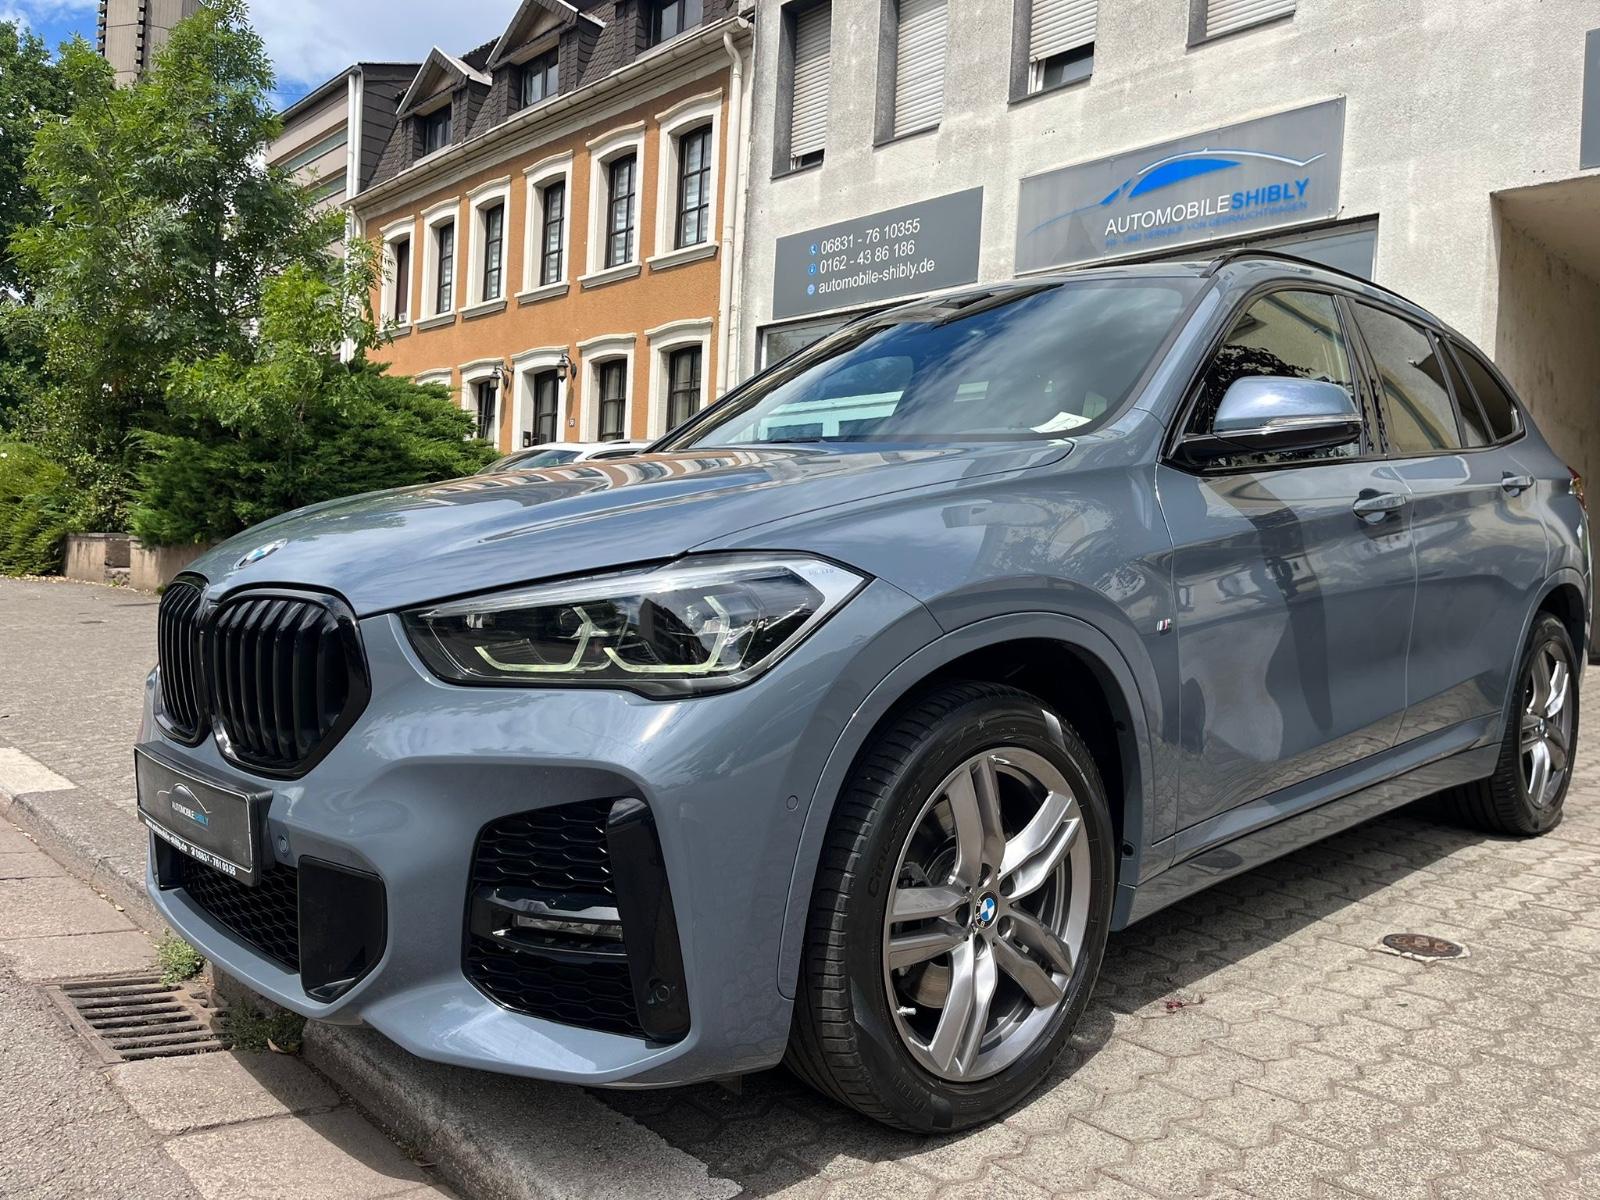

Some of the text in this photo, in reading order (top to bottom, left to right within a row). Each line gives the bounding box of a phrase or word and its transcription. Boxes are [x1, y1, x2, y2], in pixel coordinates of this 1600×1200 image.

[820, 234, 854, 255] 06831
[865, 227, 880, 244] 76
[884, 217, 921, 240] 10355
[819, 255, 847, 274] 0162
[857, 248, 872, 266] 43
[874, 245, 889, 263] 86
[893, 239, 915, 258] 186
[818, 258, 935, 294] automobile-shibly.de
